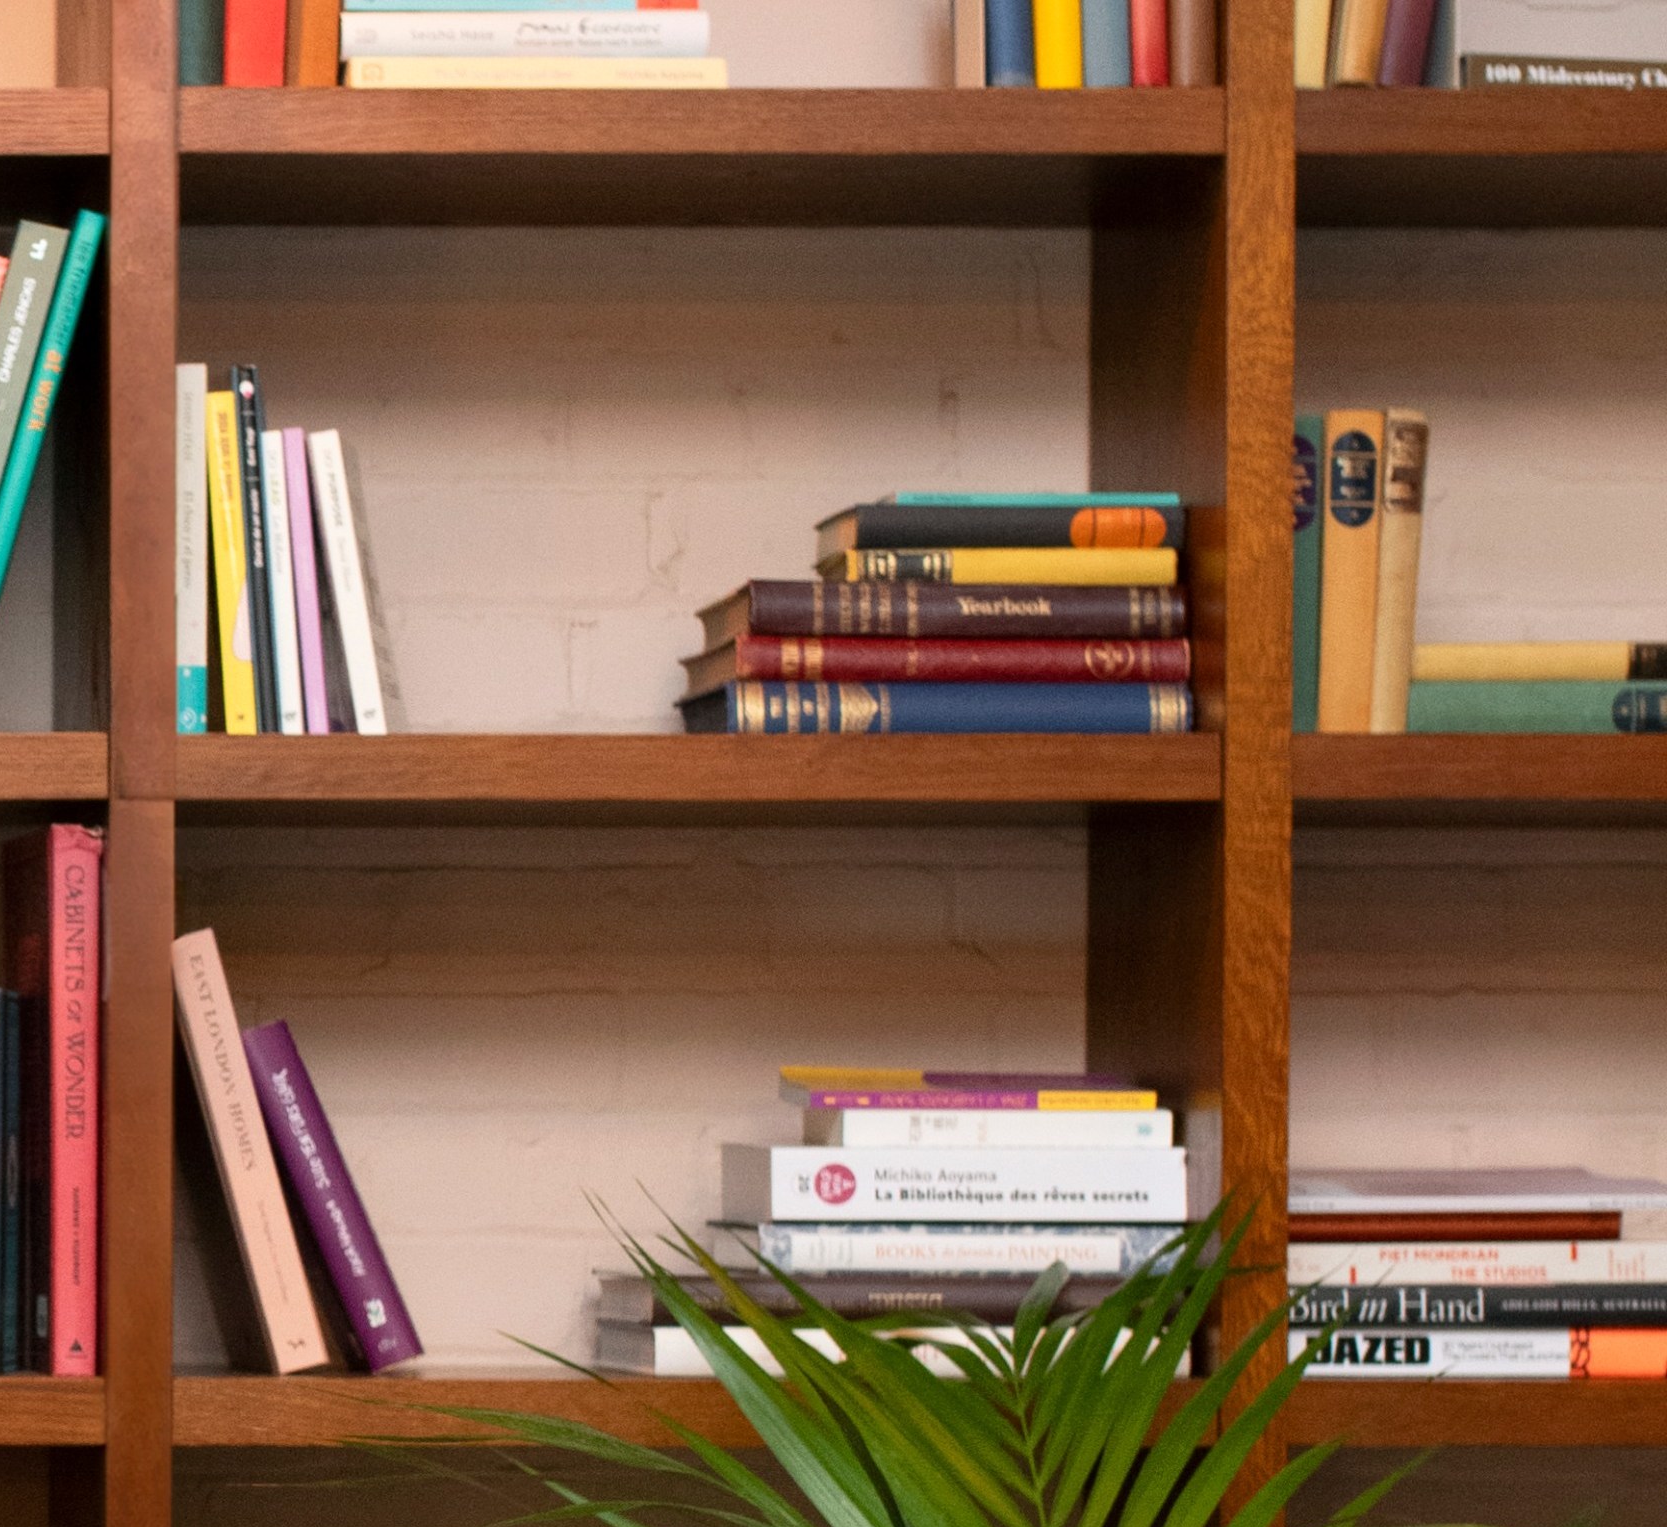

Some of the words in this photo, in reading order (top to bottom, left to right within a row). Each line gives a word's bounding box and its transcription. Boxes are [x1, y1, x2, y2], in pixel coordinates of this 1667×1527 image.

[1485, 63, 1521, 82] 100
[1528, 64, 1635, 89] Midcentury
[12, 276, 36, 325] JENCKS
[42, 349, 62, 374] at
[25, 377, 55, 432] work
[959, 597, 1052, 617] Yearbook
[65, 864, 86, 992] CABINETS
[189, 953, 215, 1004] EAST
[203, 1009, 241, 1096] LONDON
[228, 1101, 260, 1171] HOMES
[65, 1032, 85, 1140] WONDER
[875, 1168, 932, 1183] Michiko
[938, 1169, 997, 1185] Aoyama
[875, 1187, 893, 1202] La
[899, 1186, 1005, 1206] Bibliothèque
[1011, 1189, 1038, 1203] des
[1044, 1187, 1086, 1203] rêves
[1091, 1190, 1150, 1204] secrets
[875, 1243, 937, 1259] BOOKS
[1008, 1243, 1097, 1261] PAINTING
[1379, 1249, 1408, 1261] PIET
[1414, 1249, 1499, 1262] MONDRIAN
[1483, 1265, 1547, 1279] STUDIOS
[1288, 1287, 1349, 1323] Bird
[1358, 1297, 1387, 1323] in
[1398, 1287, 1485, 1323] Hand
